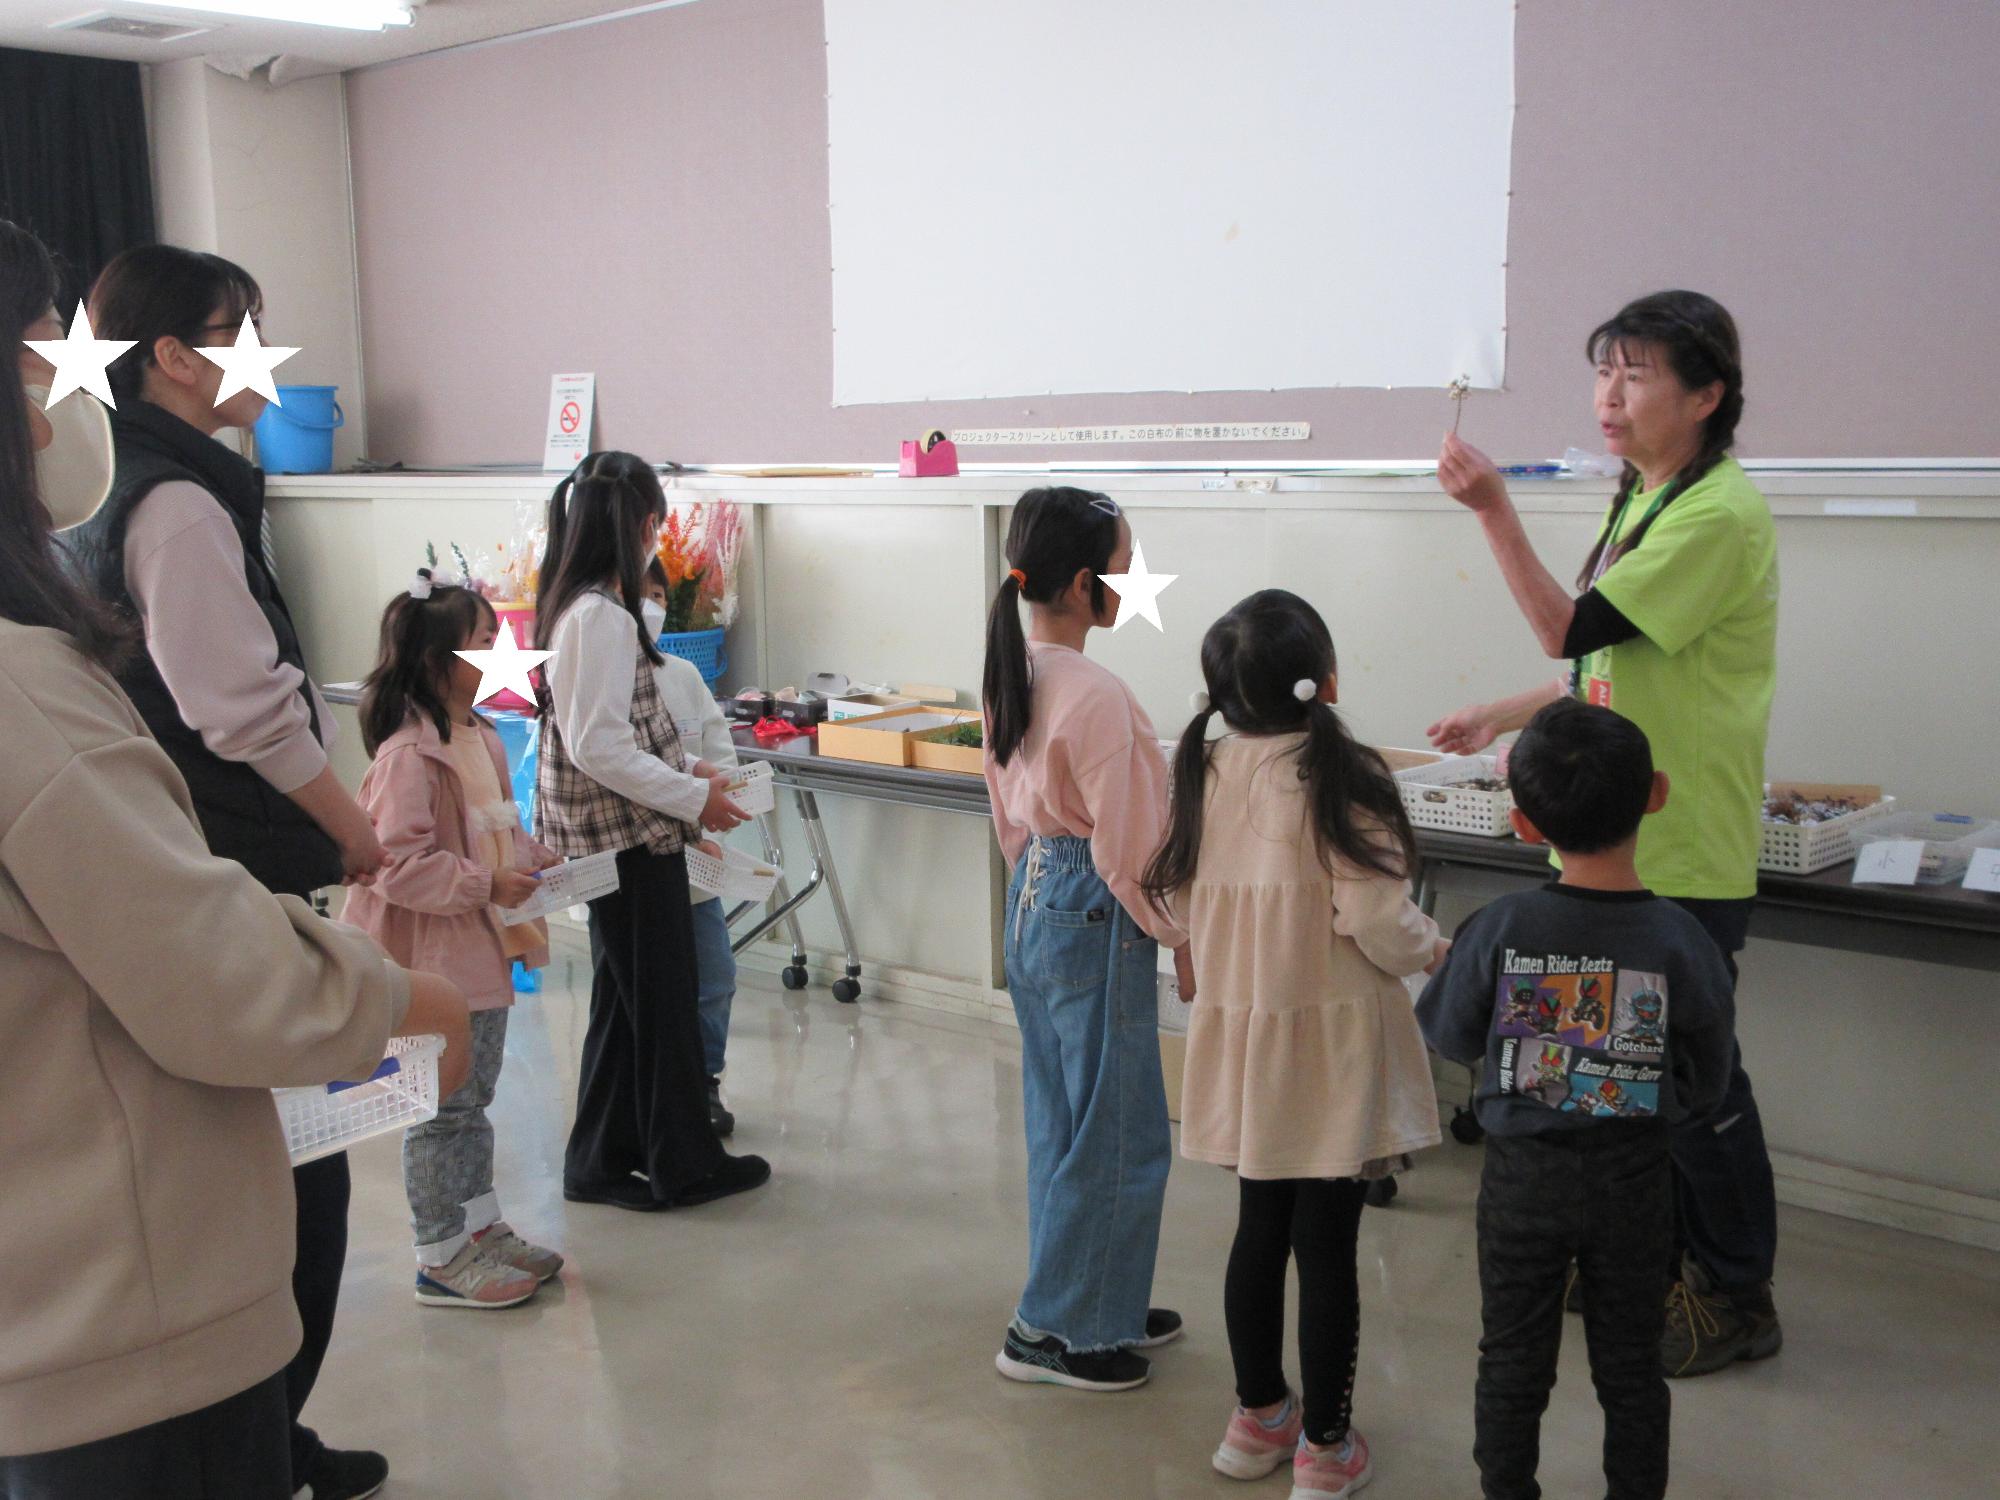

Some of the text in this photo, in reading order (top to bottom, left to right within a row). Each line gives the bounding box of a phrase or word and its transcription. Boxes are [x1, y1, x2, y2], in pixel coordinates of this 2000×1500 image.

[1504, 949, 1613, 974] Kamen Rider Zeztz
[1614, 1038, 1664, 1054] Gotchard
[1574, 1057, 1610, 1075] Kamen
[1609, 1063, 1638, 1080] Rider
